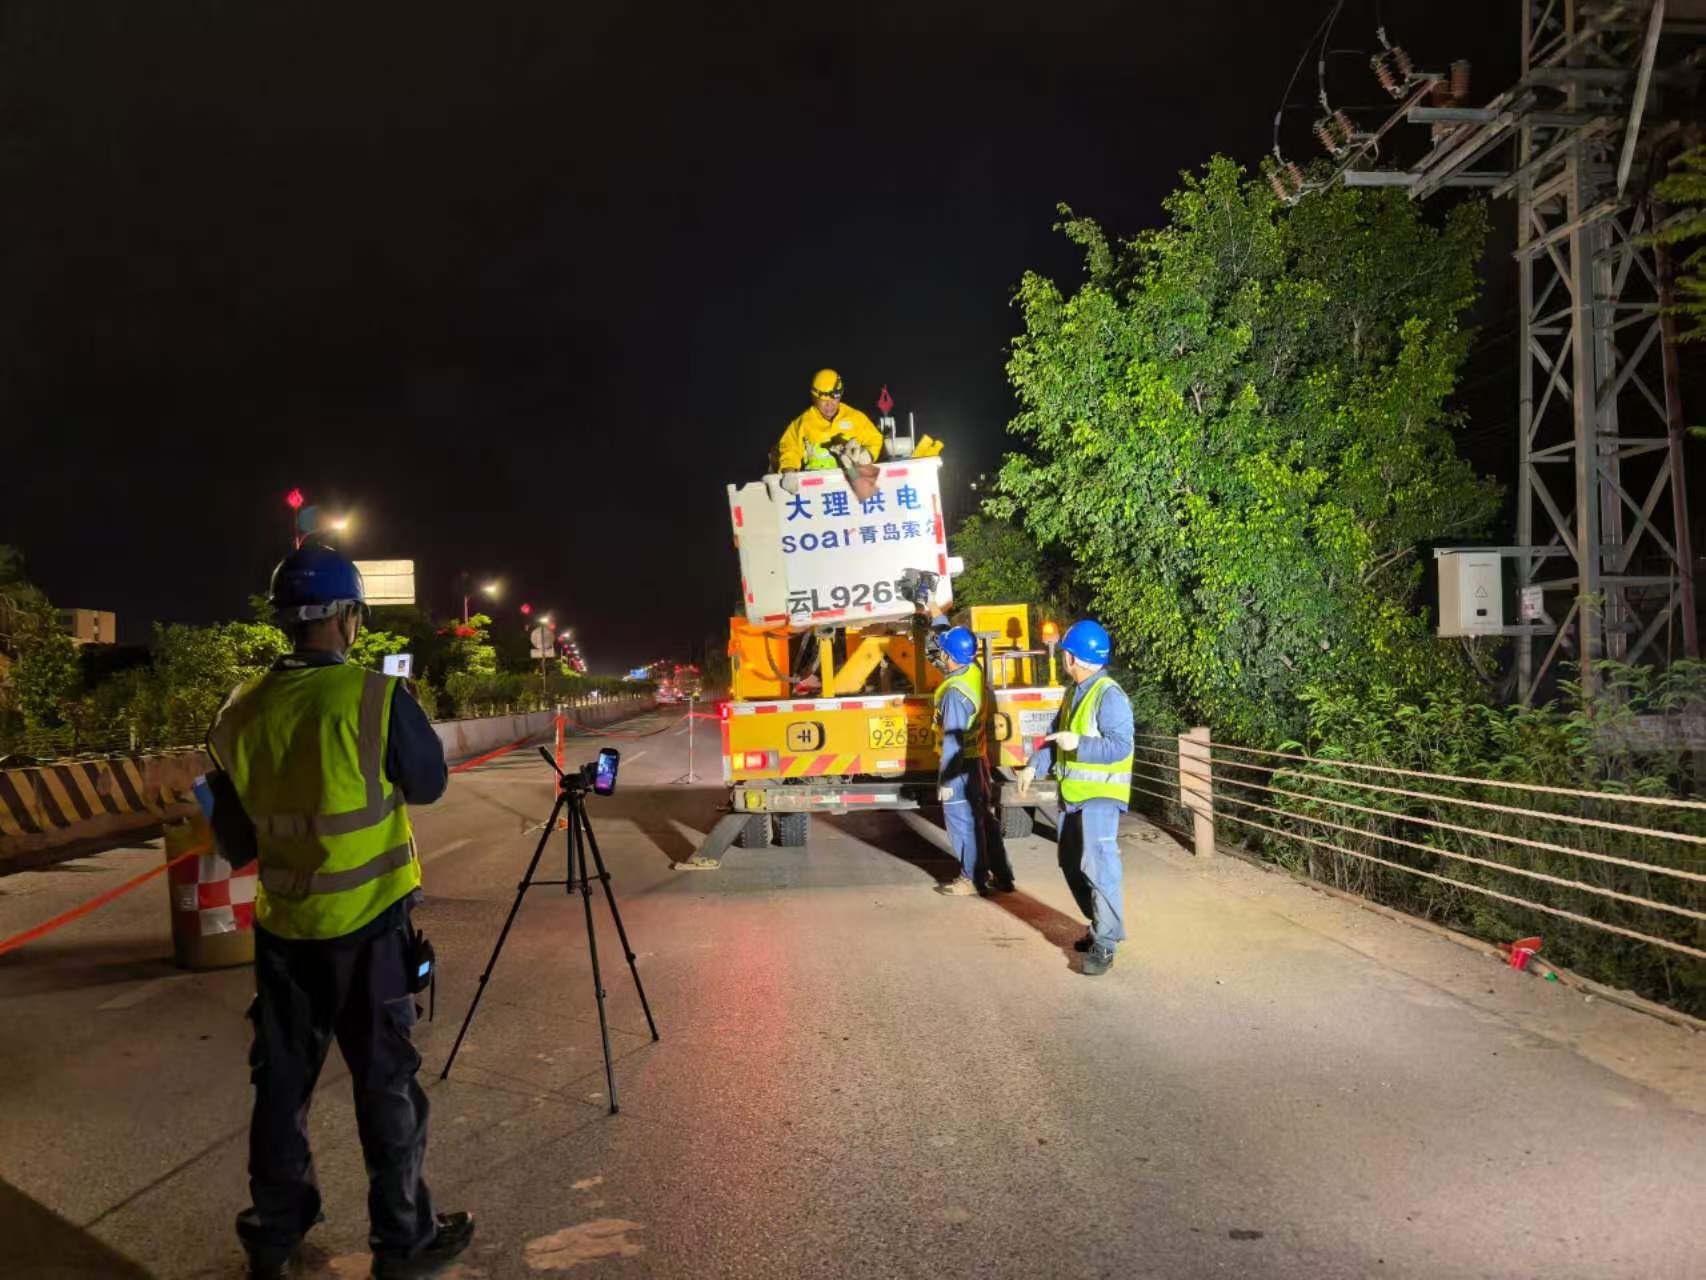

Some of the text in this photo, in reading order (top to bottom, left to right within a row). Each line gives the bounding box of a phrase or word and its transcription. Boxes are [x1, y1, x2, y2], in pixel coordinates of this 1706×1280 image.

[785, 484, 921, 521] 大理供电
[788, 580, 912, 614] 云L9265
[872, 727, 929, 746] 92659
